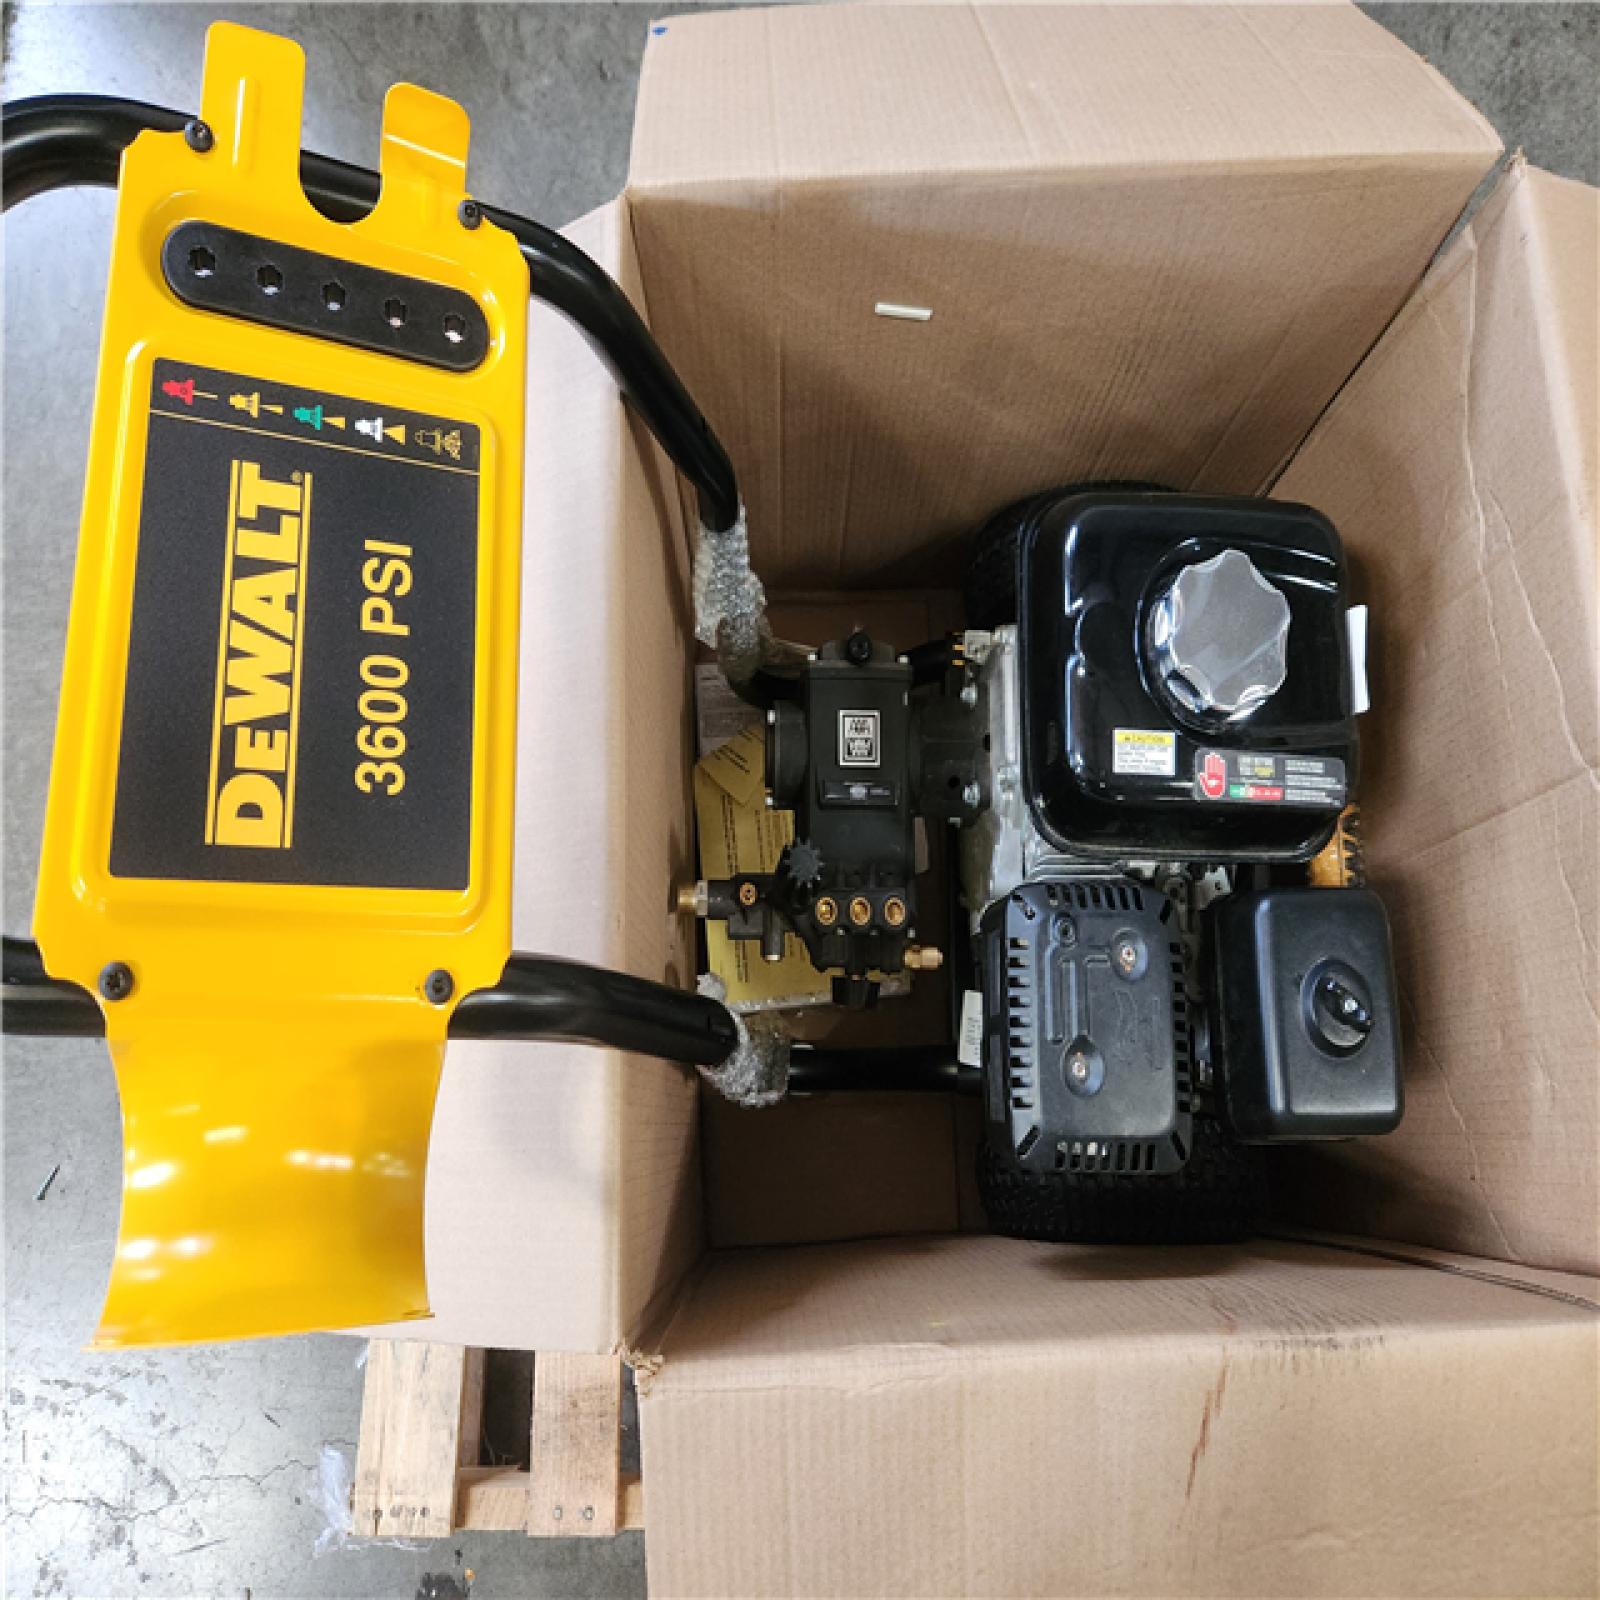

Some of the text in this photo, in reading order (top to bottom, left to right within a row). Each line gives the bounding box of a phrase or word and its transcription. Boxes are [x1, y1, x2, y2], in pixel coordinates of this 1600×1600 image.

[214, 460, 303, 847] DEWALT
[355, 539, 414, 796] 3600 PSI
